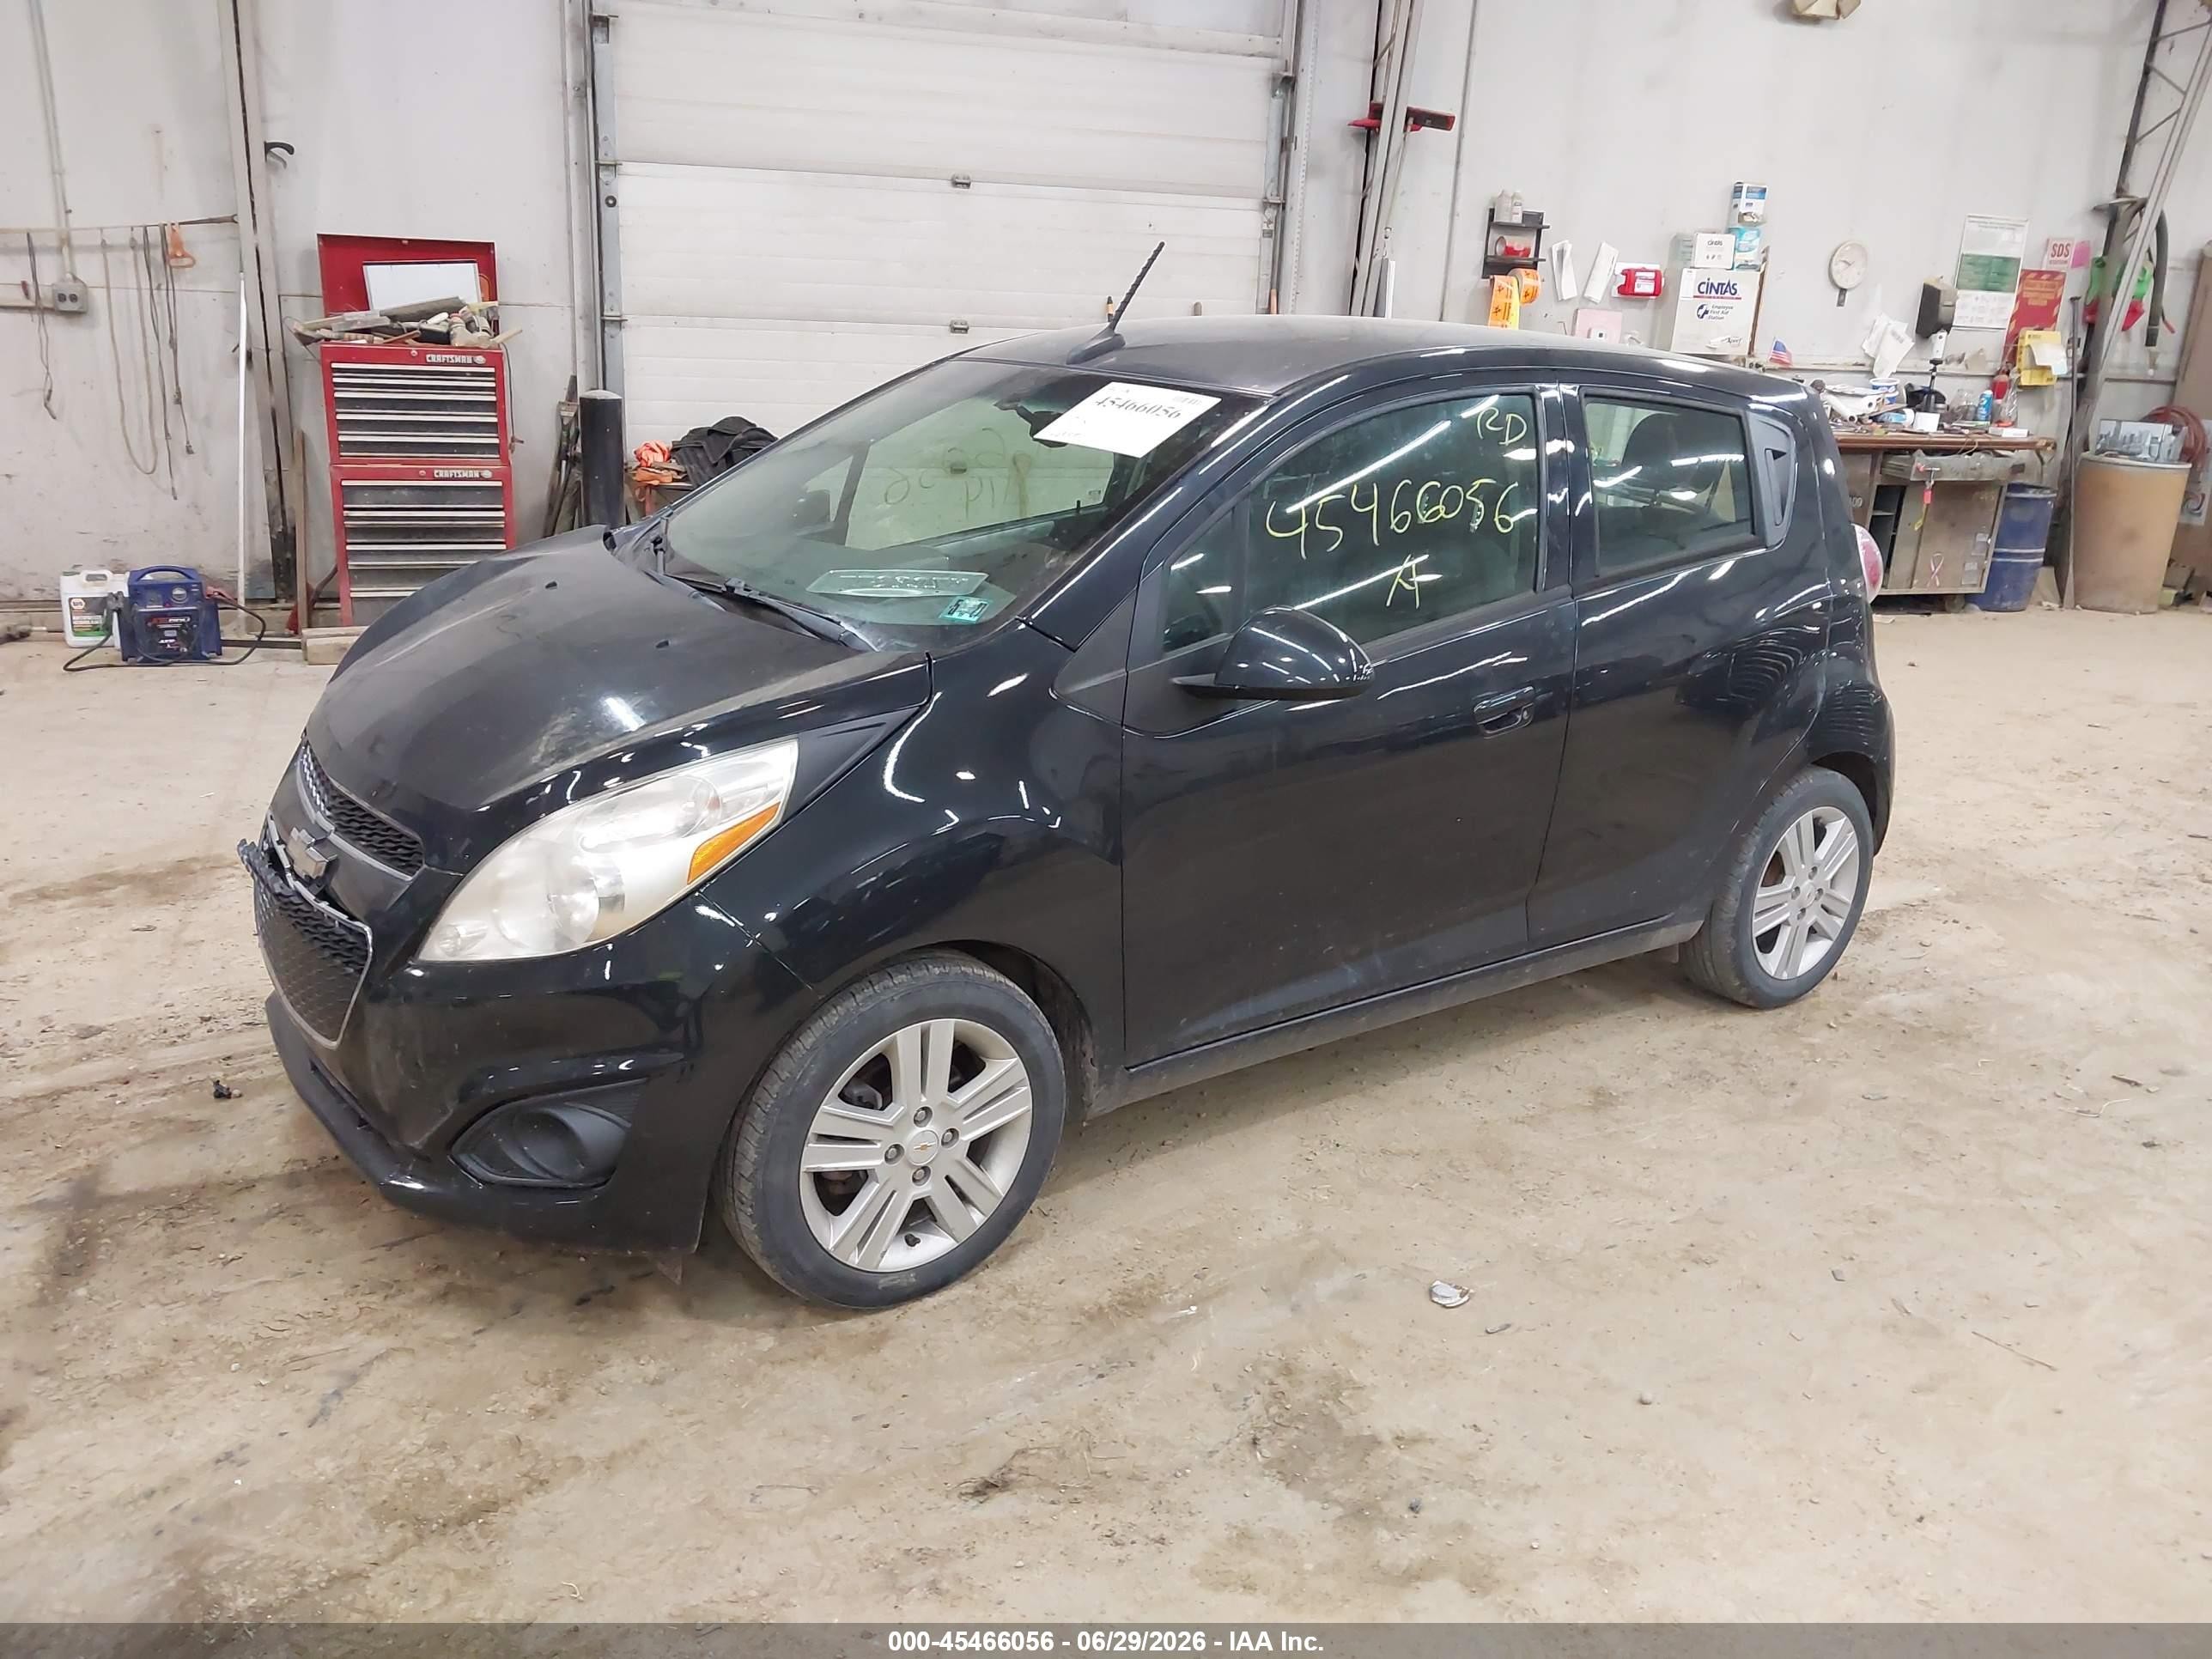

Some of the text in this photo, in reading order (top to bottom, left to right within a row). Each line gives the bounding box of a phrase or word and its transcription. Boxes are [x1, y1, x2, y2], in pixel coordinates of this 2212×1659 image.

[2050, 243, 2071, 258] SDS
[1697, 277, 1738, 295] CINTAS
[426, 354, 472, 363] CRAFTSMAN
[1095, 396, 1182, 420] 45466056
[434, 470, 480, 478] CRAFTSMAN
[1265, 477, 1520, 560] 45466056
